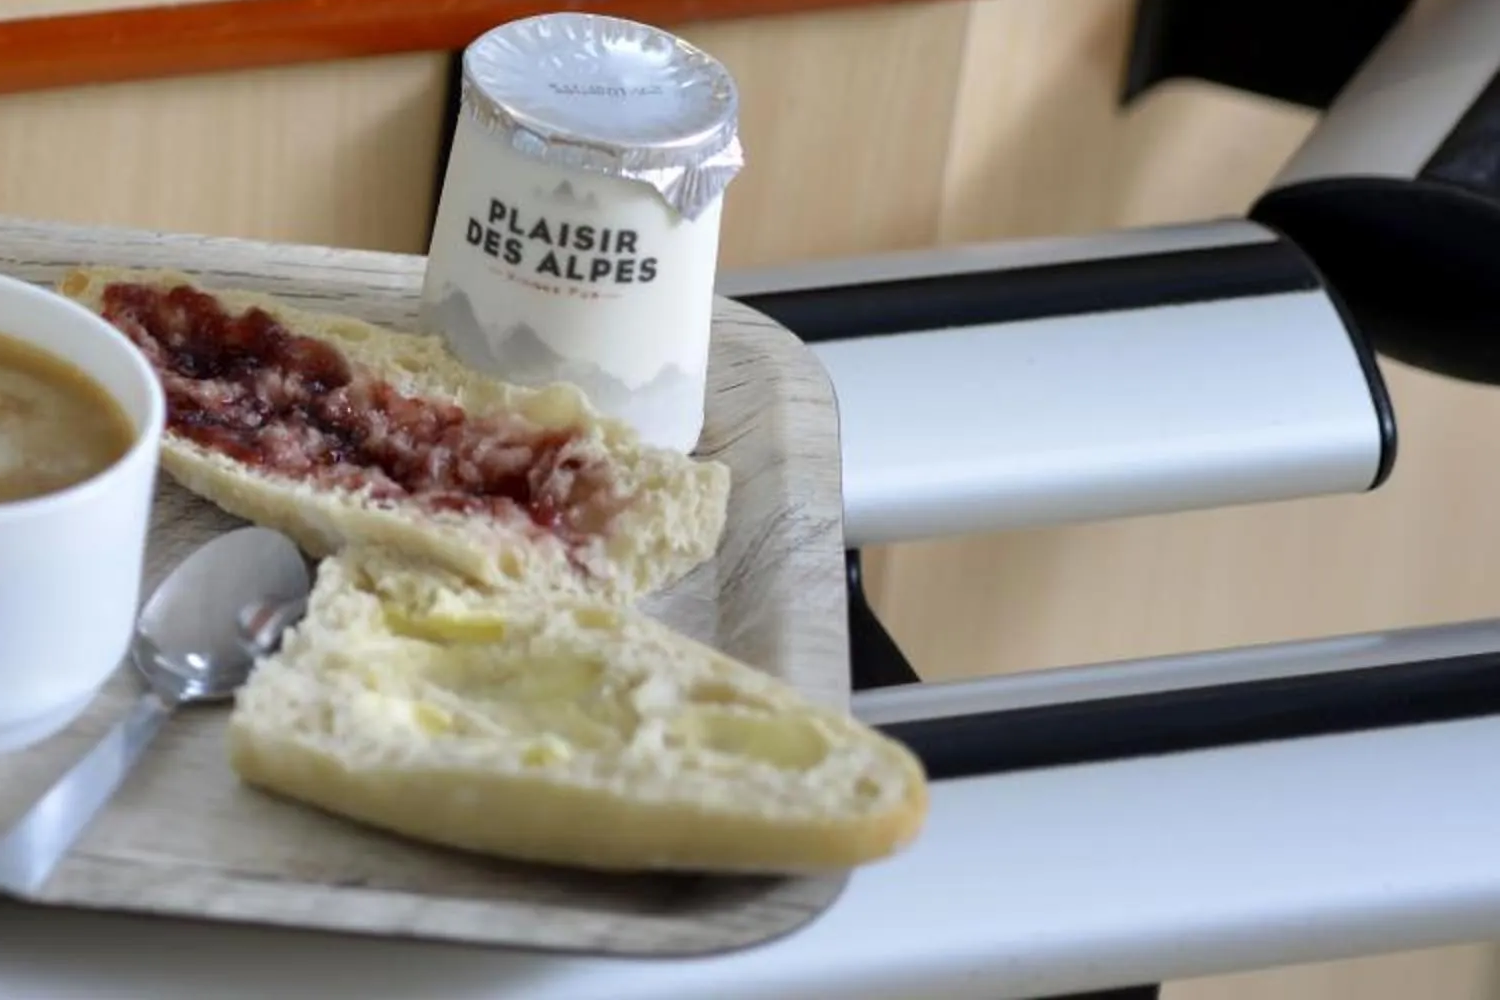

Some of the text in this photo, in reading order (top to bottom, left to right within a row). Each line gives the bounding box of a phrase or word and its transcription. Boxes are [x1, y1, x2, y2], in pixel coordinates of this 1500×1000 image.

[466, 217, 658, 284] DES ALPES
[488, 197, 639, 254] PLAISIR
